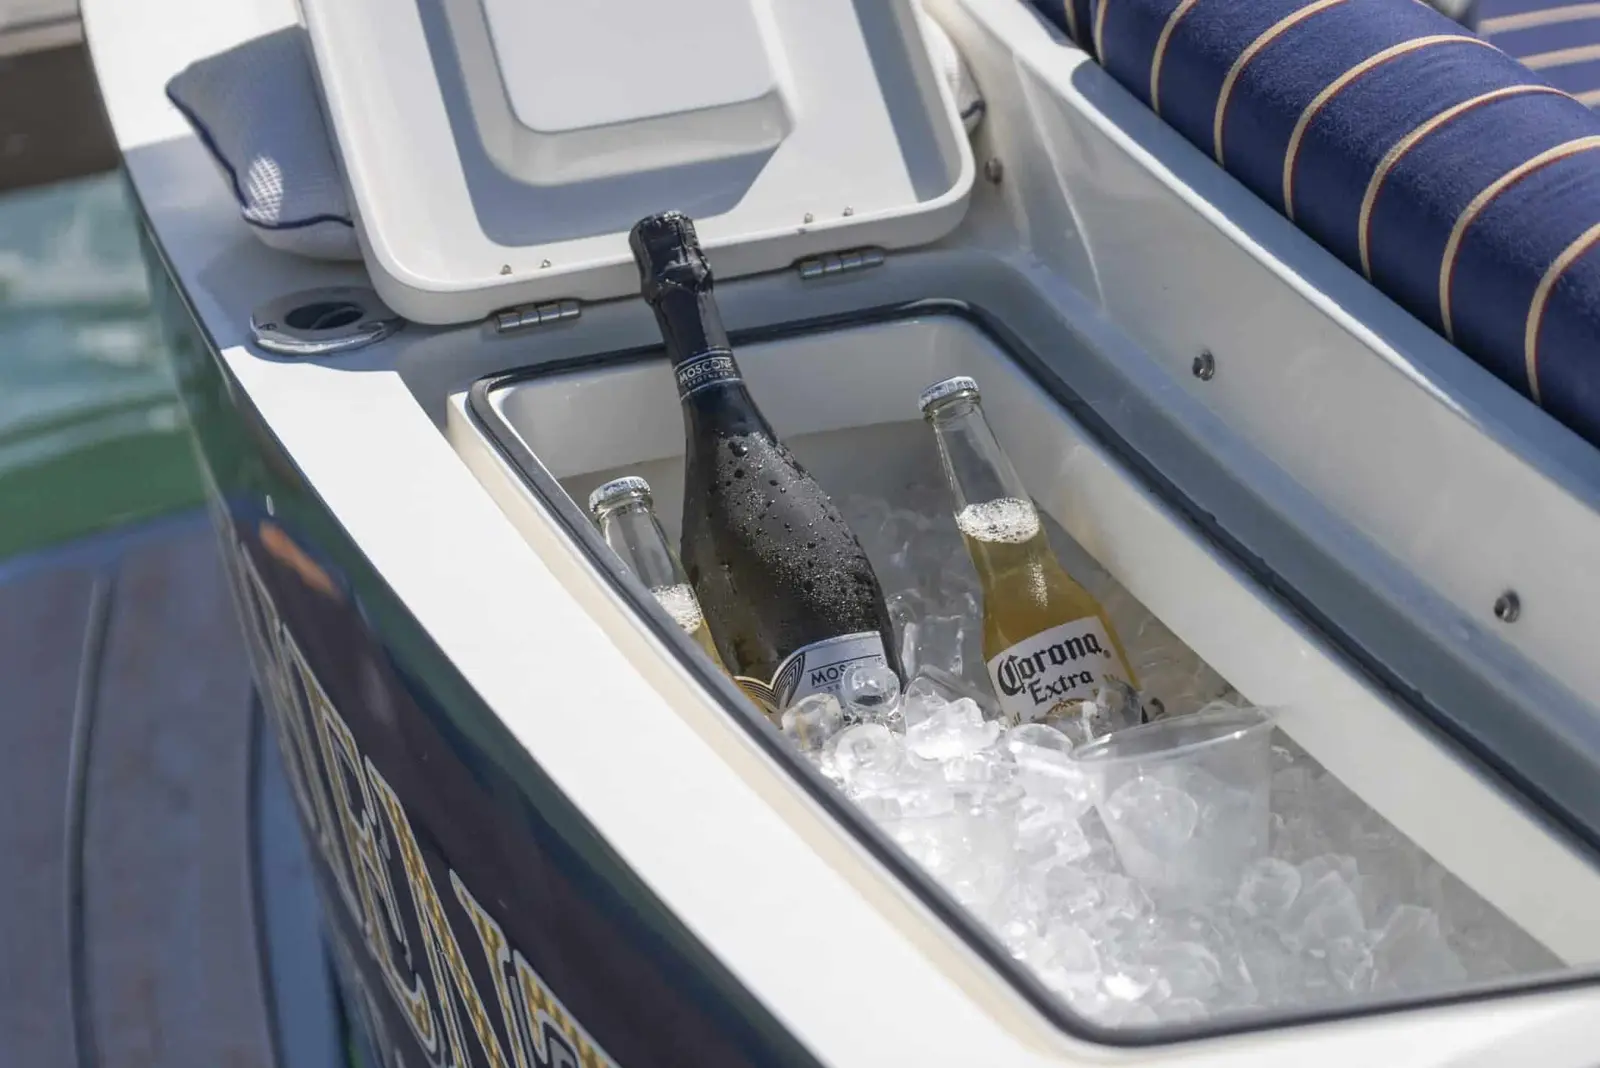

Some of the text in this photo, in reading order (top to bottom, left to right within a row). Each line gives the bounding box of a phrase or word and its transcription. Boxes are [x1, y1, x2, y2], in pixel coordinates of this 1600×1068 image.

[811, 662, 851, 687] MOS
[997, 632, 1104, 696] Corona
[1028, 670, 1094, 706] Extra
